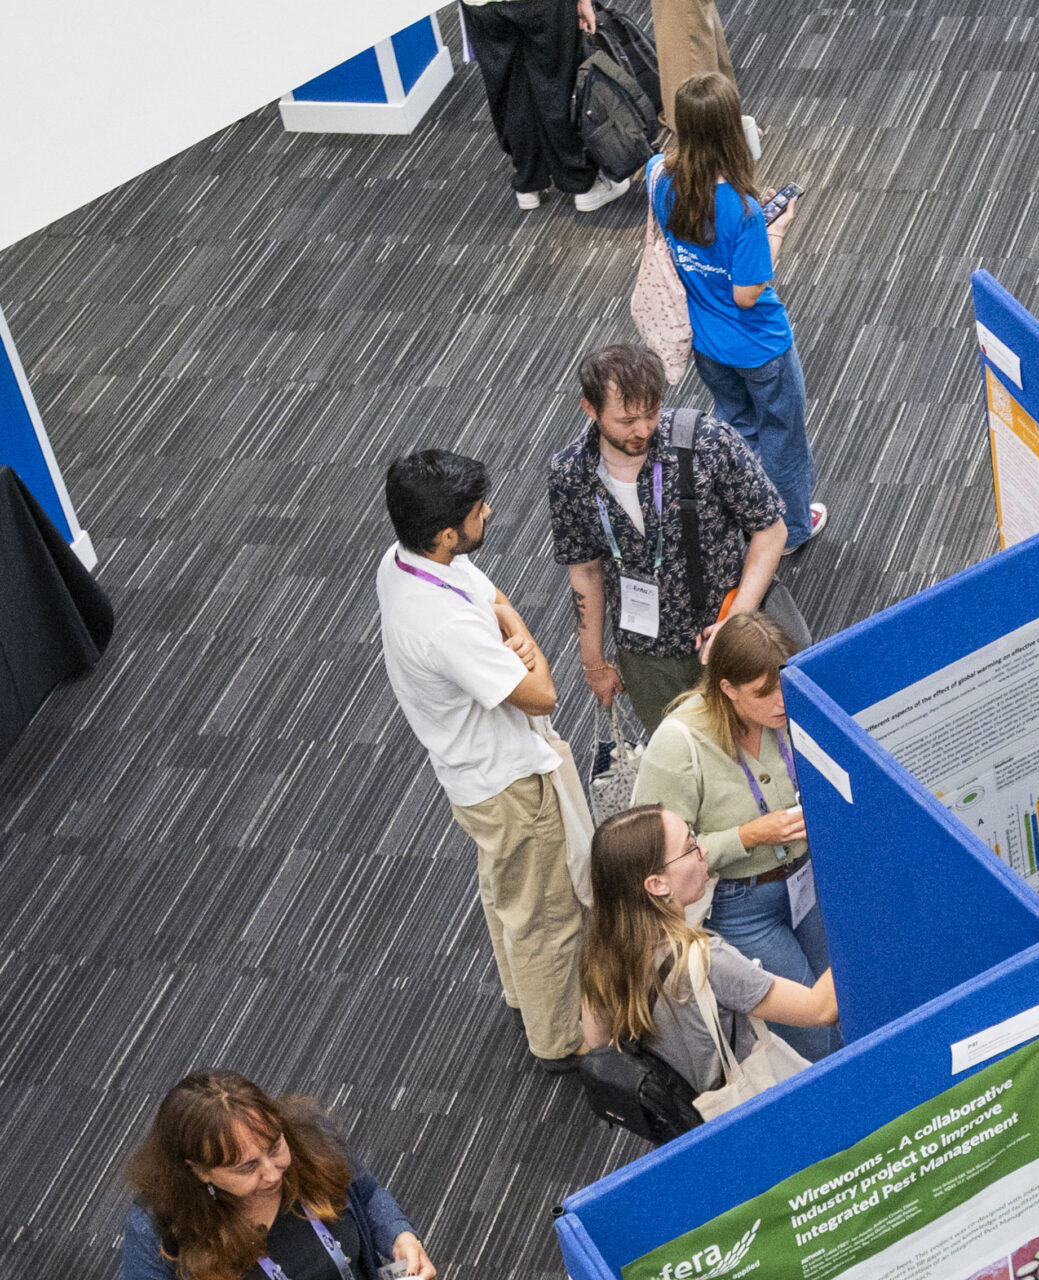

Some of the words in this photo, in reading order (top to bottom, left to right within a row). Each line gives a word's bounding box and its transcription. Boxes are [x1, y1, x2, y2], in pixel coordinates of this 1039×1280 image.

[891, 704, 913, 721] aspects
[932, 684, 949, 698] effect
[958, 671, 975, 685] global
[976, 657, 1001, 676] warming
[1011, 639, 1035, 656] effective
[977, 816, 984, 827] A
[788, 1149, 882, 1213] Wireworms
[898, 1132, 912, 1150] A
[913, 1076, 1013, 1143] collaborative
[791, 1181, 857, 1231] industry
[859, 1147, 918, 1194] project
[920, 1137, 938, 1159] to
[940, 1101, 1002, 1148] improve
[795, 1188, 878, 1249] Integrated
[882, 1168, 916, 1200] Pest
[919, 1111, 1018, 1179] Management
[731, 1258, 760, 1280] applied
